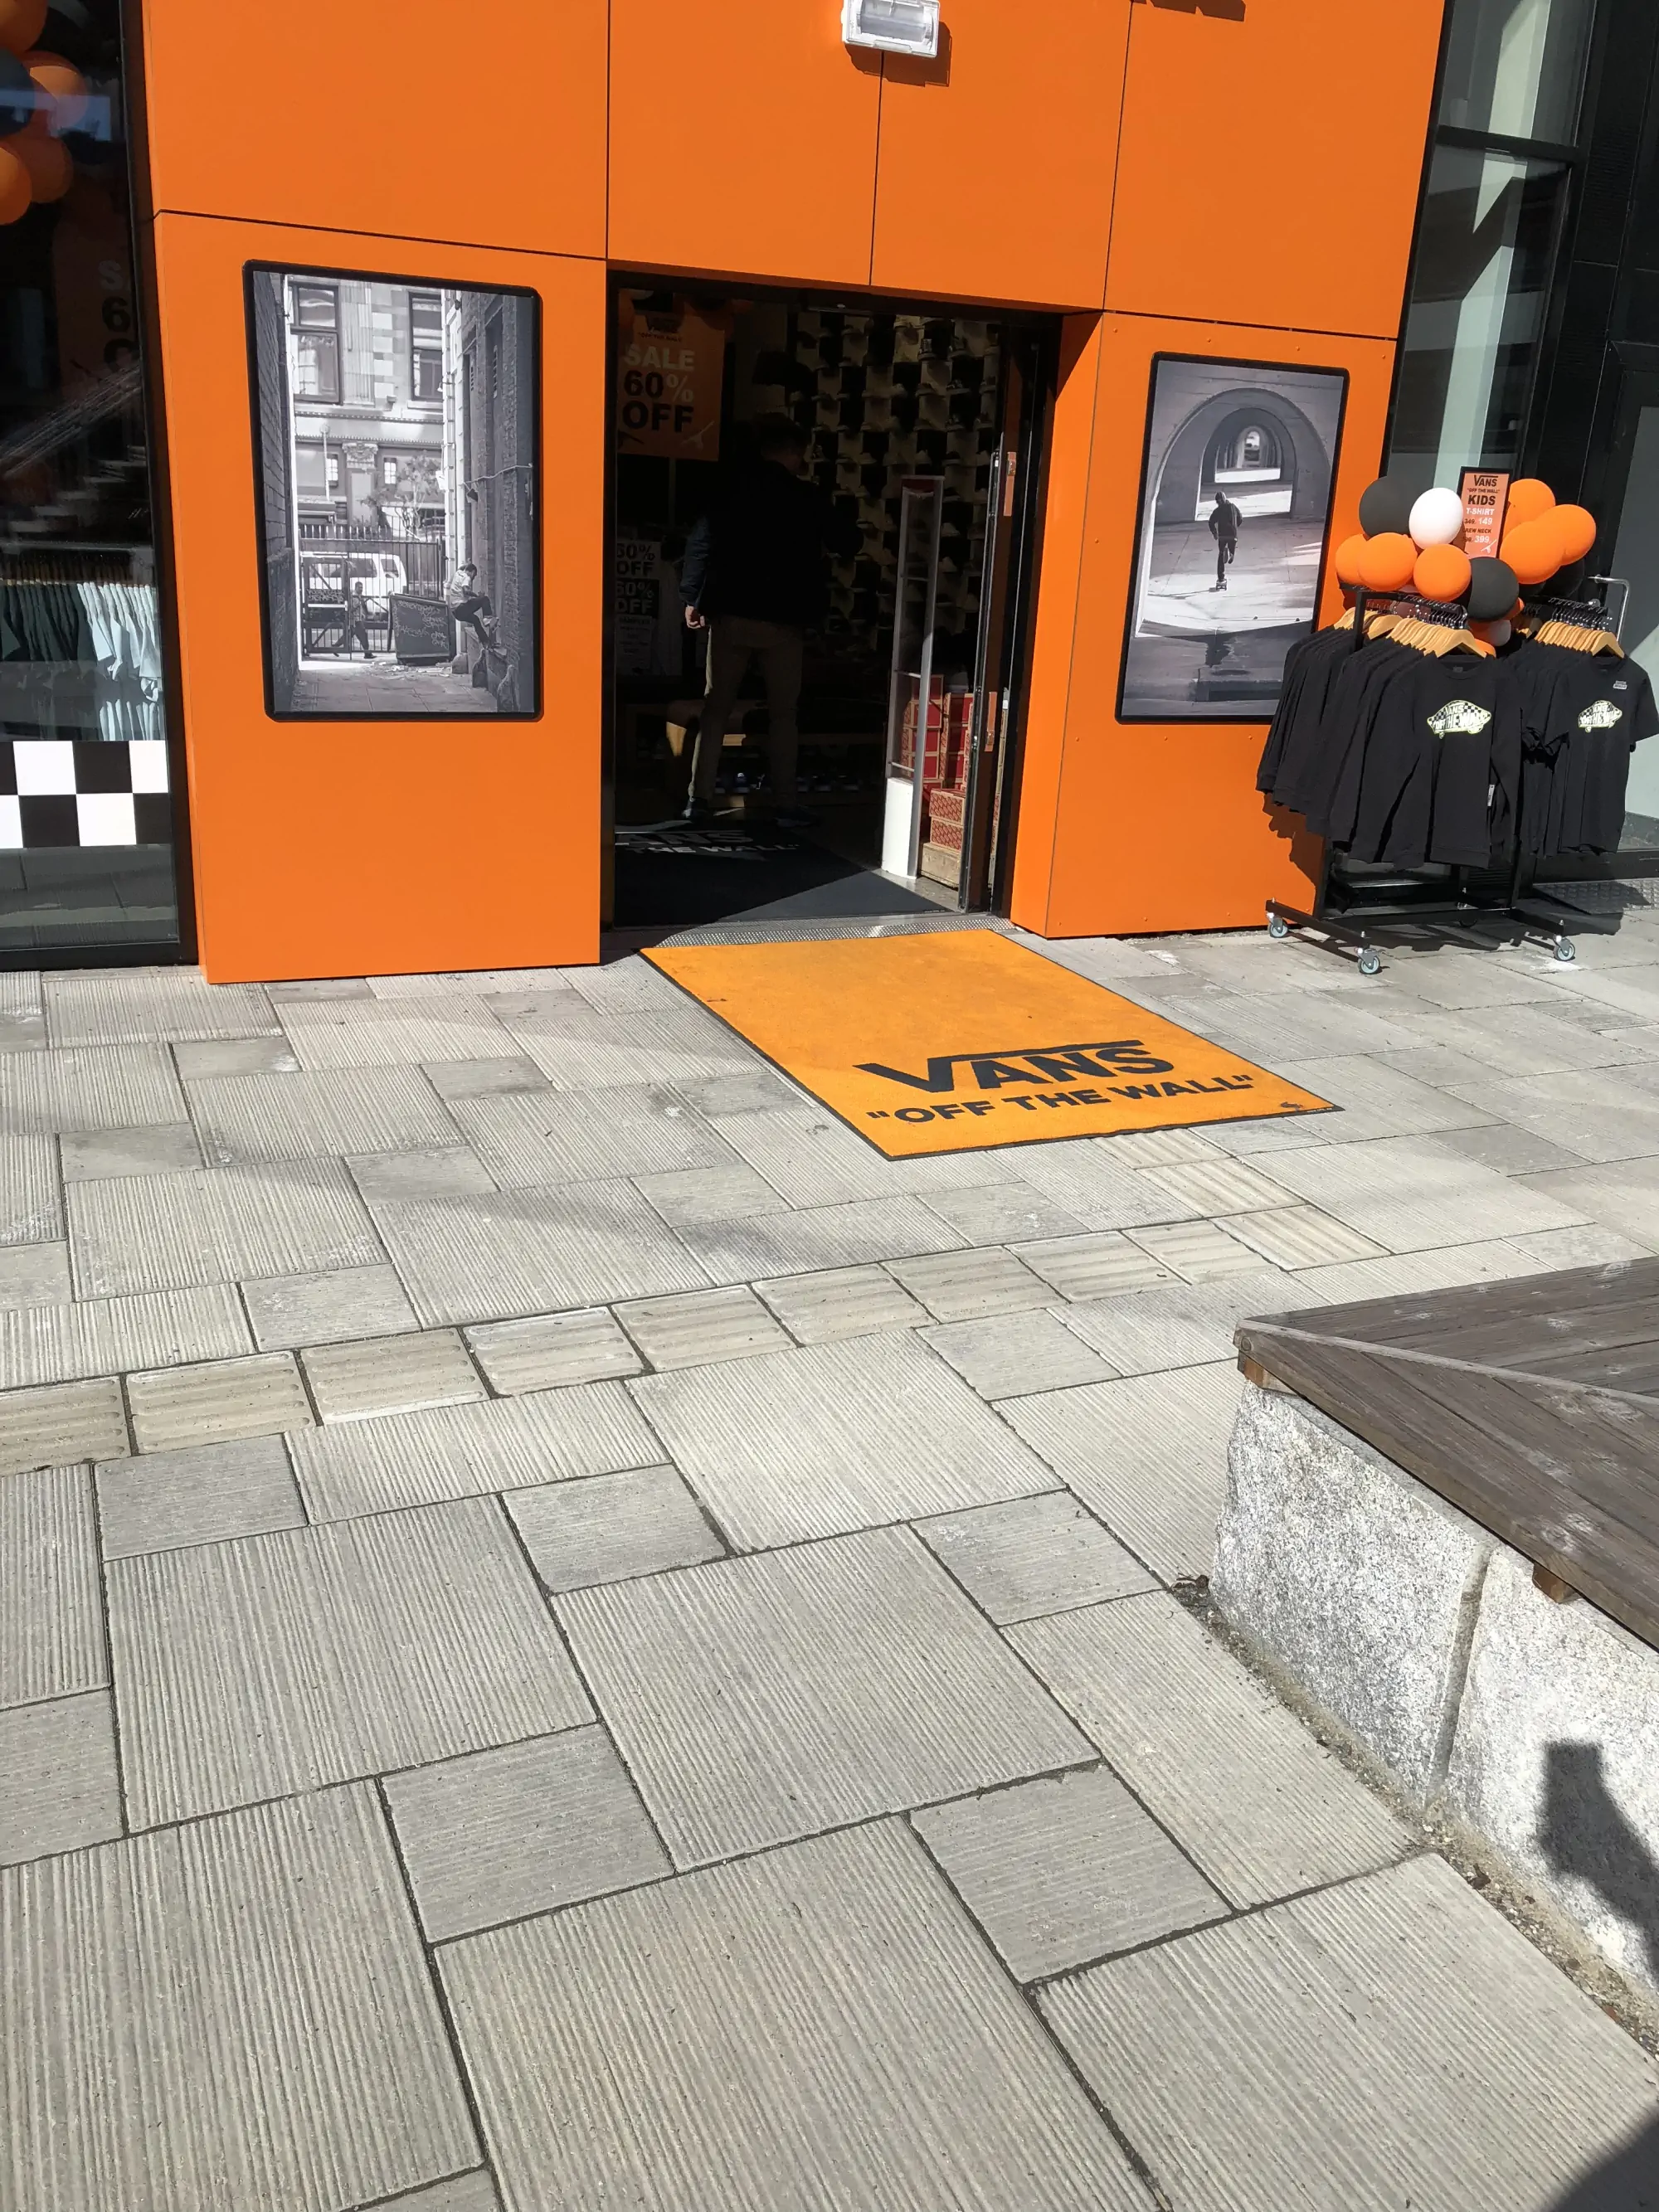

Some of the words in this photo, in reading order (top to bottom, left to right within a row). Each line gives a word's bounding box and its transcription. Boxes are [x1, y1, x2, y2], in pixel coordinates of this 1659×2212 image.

[624, 343, 695, 372] SALE
[623, 370, 694, 403] 60%
[621, 400, 695, 433] OFF
[1474, 474, 1499, 487] VANS
[1466, 508, 1496, 516] T-SHIRT
[1467, 494, 1496, 506] KIDS
[616, 560, 654, 577] OFF
[853, 1039, 1174, 1093] VANS
[866, 1100, 995, 1124] "OFF
[1000, 1088, 1112, 1111] THE
[1107, 1074, 1255, 1101] WALL"
